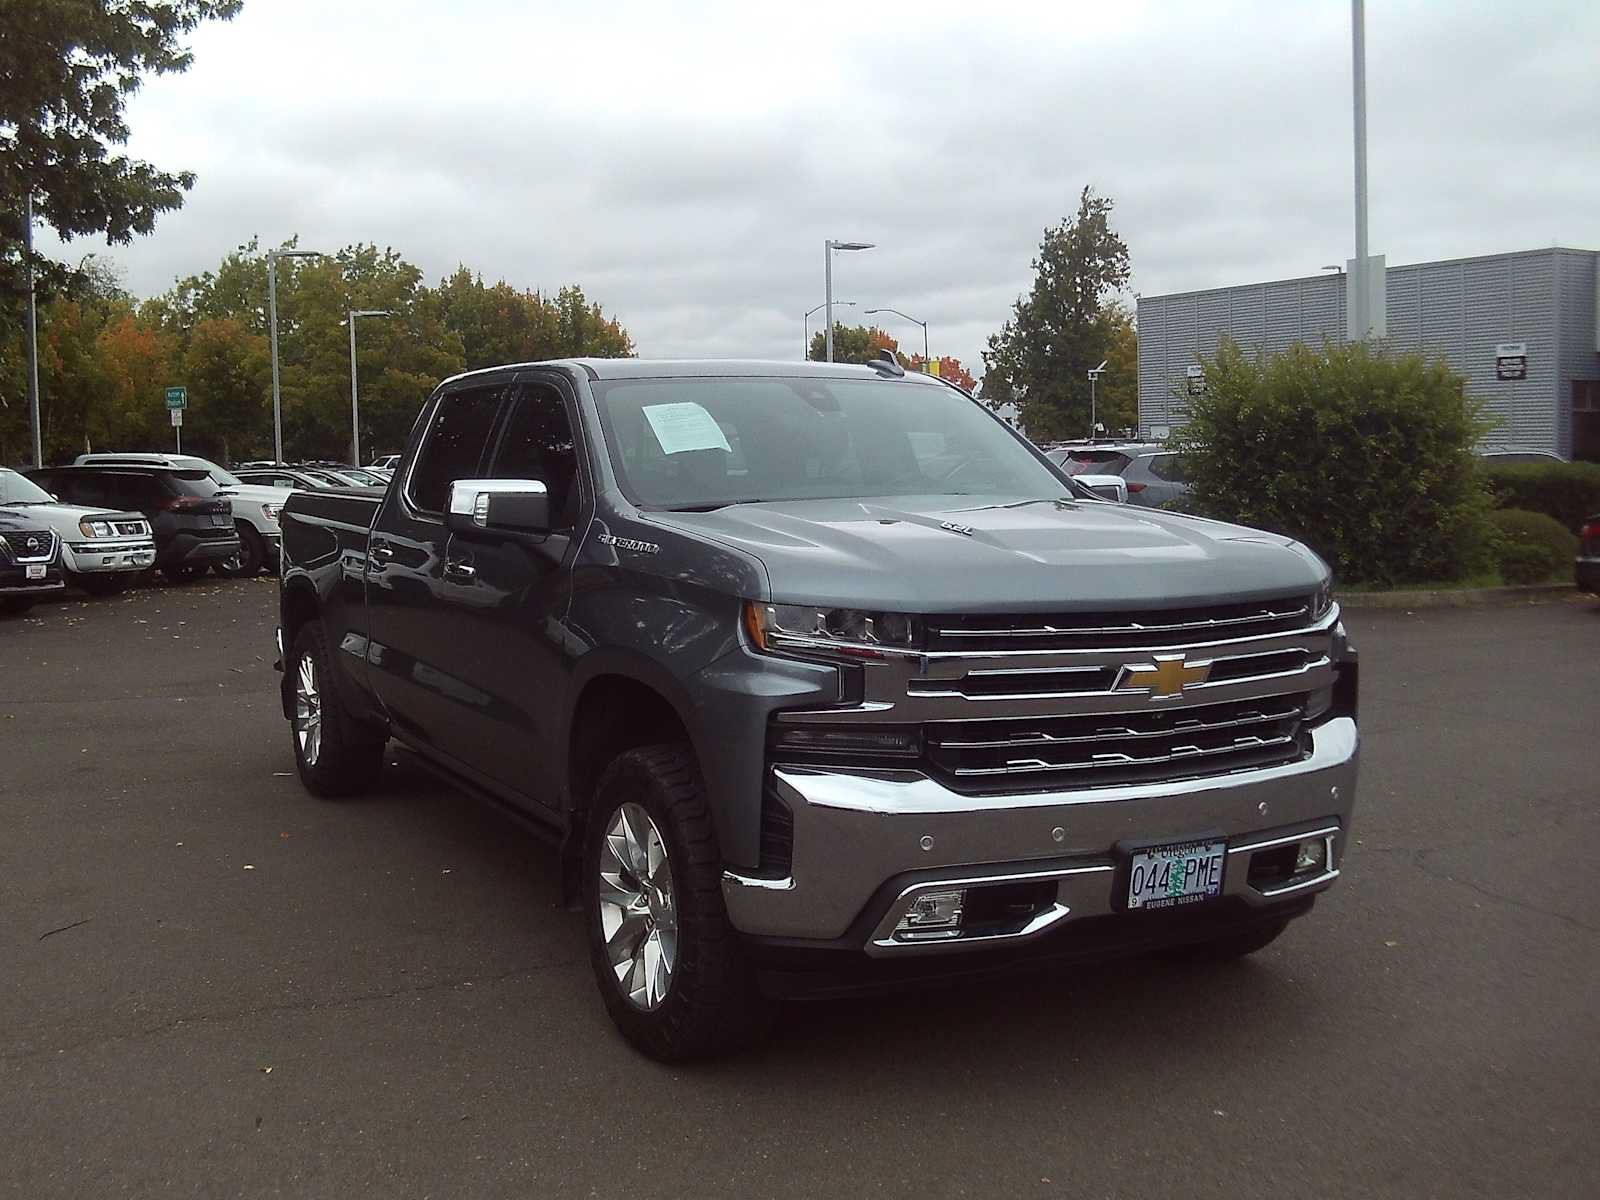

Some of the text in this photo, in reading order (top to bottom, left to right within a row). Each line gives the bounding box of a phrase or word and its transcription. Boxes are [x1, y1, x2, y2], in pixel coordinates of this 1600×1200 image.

[1132, 855, 1222, 896] 044 PME
[1146, 894, 1204, 910] EUGENE NISSAN
